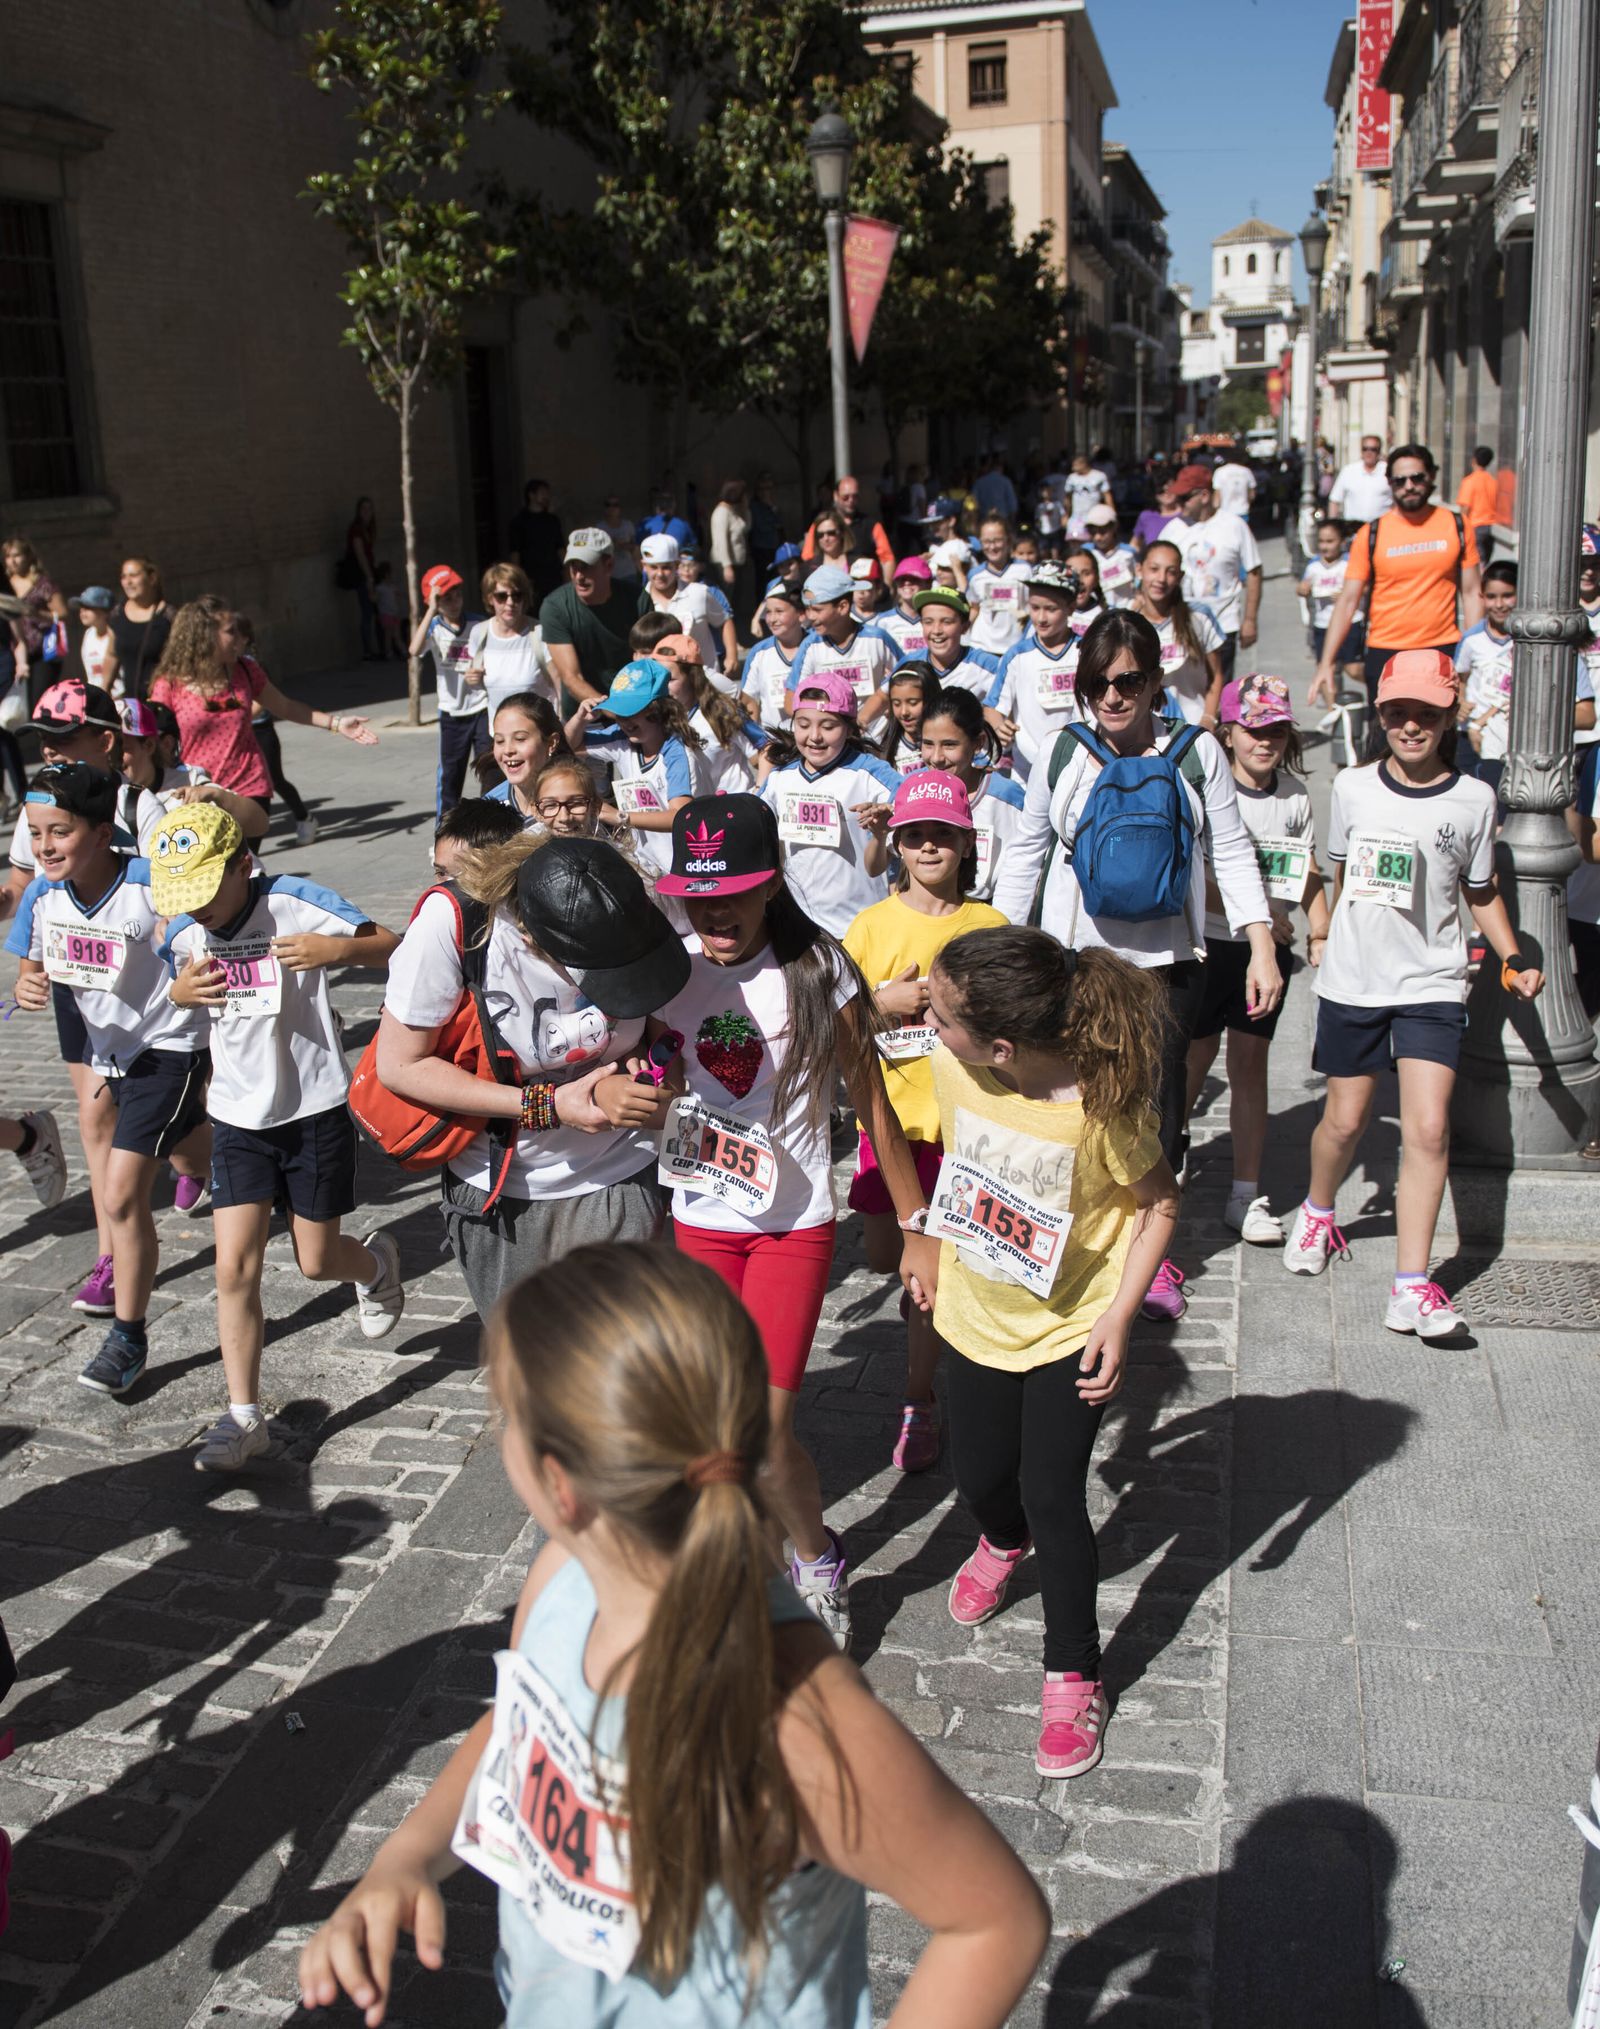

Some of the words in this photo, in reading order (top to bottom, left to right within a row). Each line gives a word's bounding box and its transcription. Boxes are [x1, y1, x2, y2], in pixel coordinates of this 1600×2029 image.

[909, 782, 953, 799] LUCIA
[802, 804, 824, 823] 931
[686, 859, 727, 873] adidas
[1367, 879, 1396, 889] CARMEN
[73, 938, 107, 964] 918
[76, 964, 109, 974] PURISIMA
[902, 1029, 926, 1040] REYES
[708, 1111, 733, 1126] ESCOLAR
[751, 1128, 759, 1137] DE
[705, 1131, 758, 1178] 155
[672, 1157, 695, 1169] CEIP
[695, 1161, 723, 1179] REYES
[956, 1163, 985, 1180] CARRERA
[984, 1177, 1010, 1196] ESCOLAR
[1010, 1191, 1028, 1208] NARIZ
[1027, 1203, 1037, 1213] DE
[1036, 1210, 1063, 1225] PAYASO
[989, 1187, 997, 1196] de
[996, 1192, 1013, 1206] MAYO
[1012, 1202, 1026, 1214] 2017
[1029, 1213, 1048, 1227] SANTA
[943, 1212, 967, 1227] CEIP
[967, 1221, 996, 1243] REYES
[979, 1196, 1033, 1250] 153
[530, 1756, 591, 1878] 164
